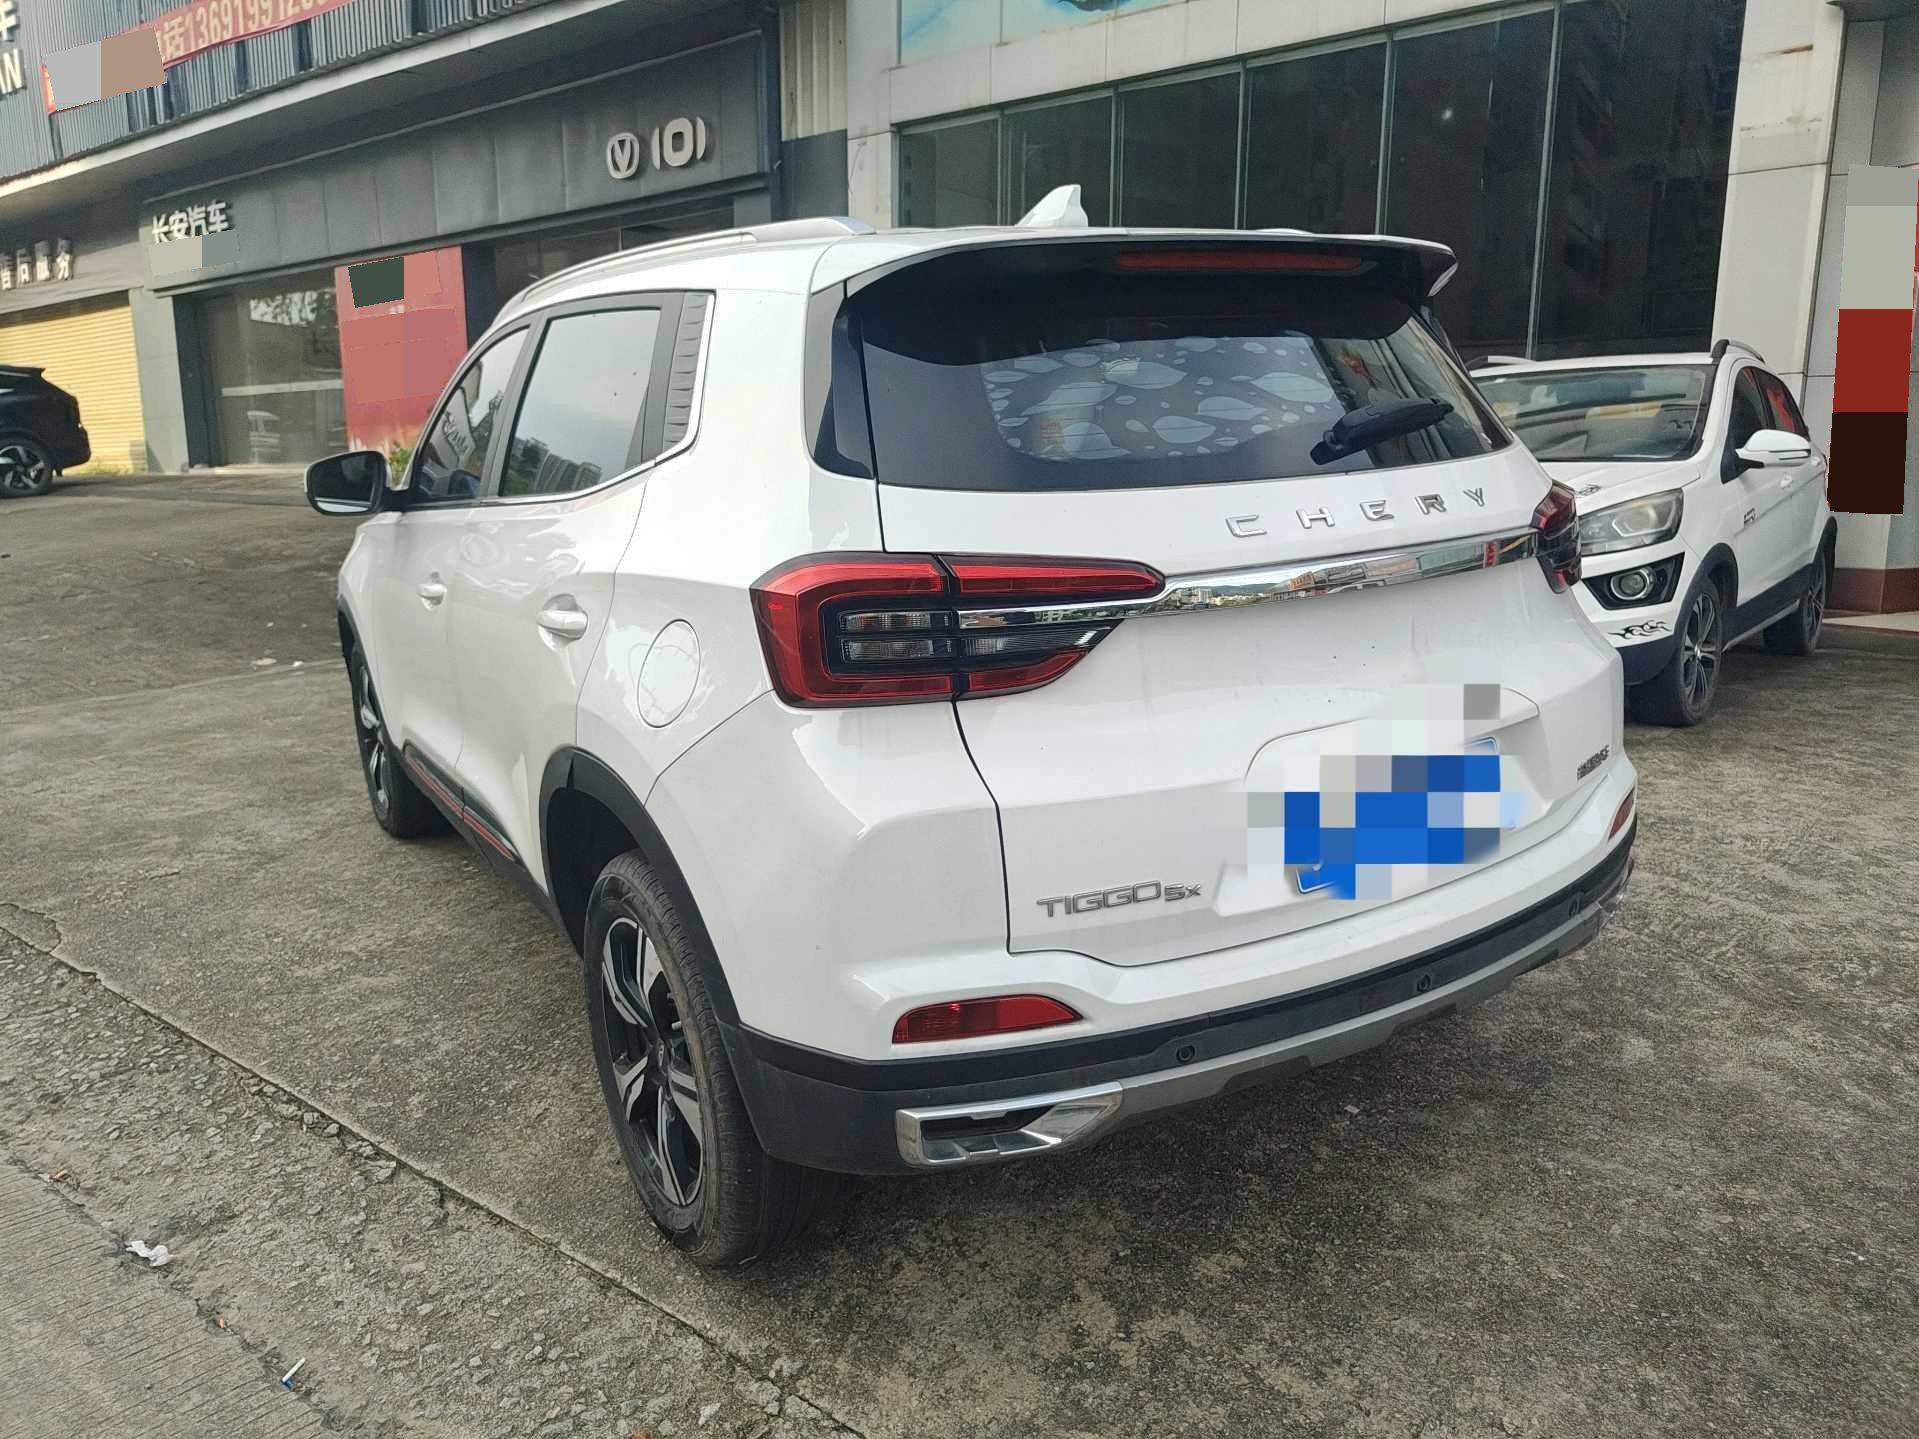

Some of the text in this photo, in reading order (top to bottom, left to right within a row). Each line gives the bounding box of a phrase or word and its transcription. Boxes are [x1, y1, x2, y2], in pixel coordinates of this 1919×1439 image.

[152, 200, 230, 243] 长安汽车
[1225, 487, 1486, 538] CHERY
[1036, 880, 1162, 917] TIGGO
